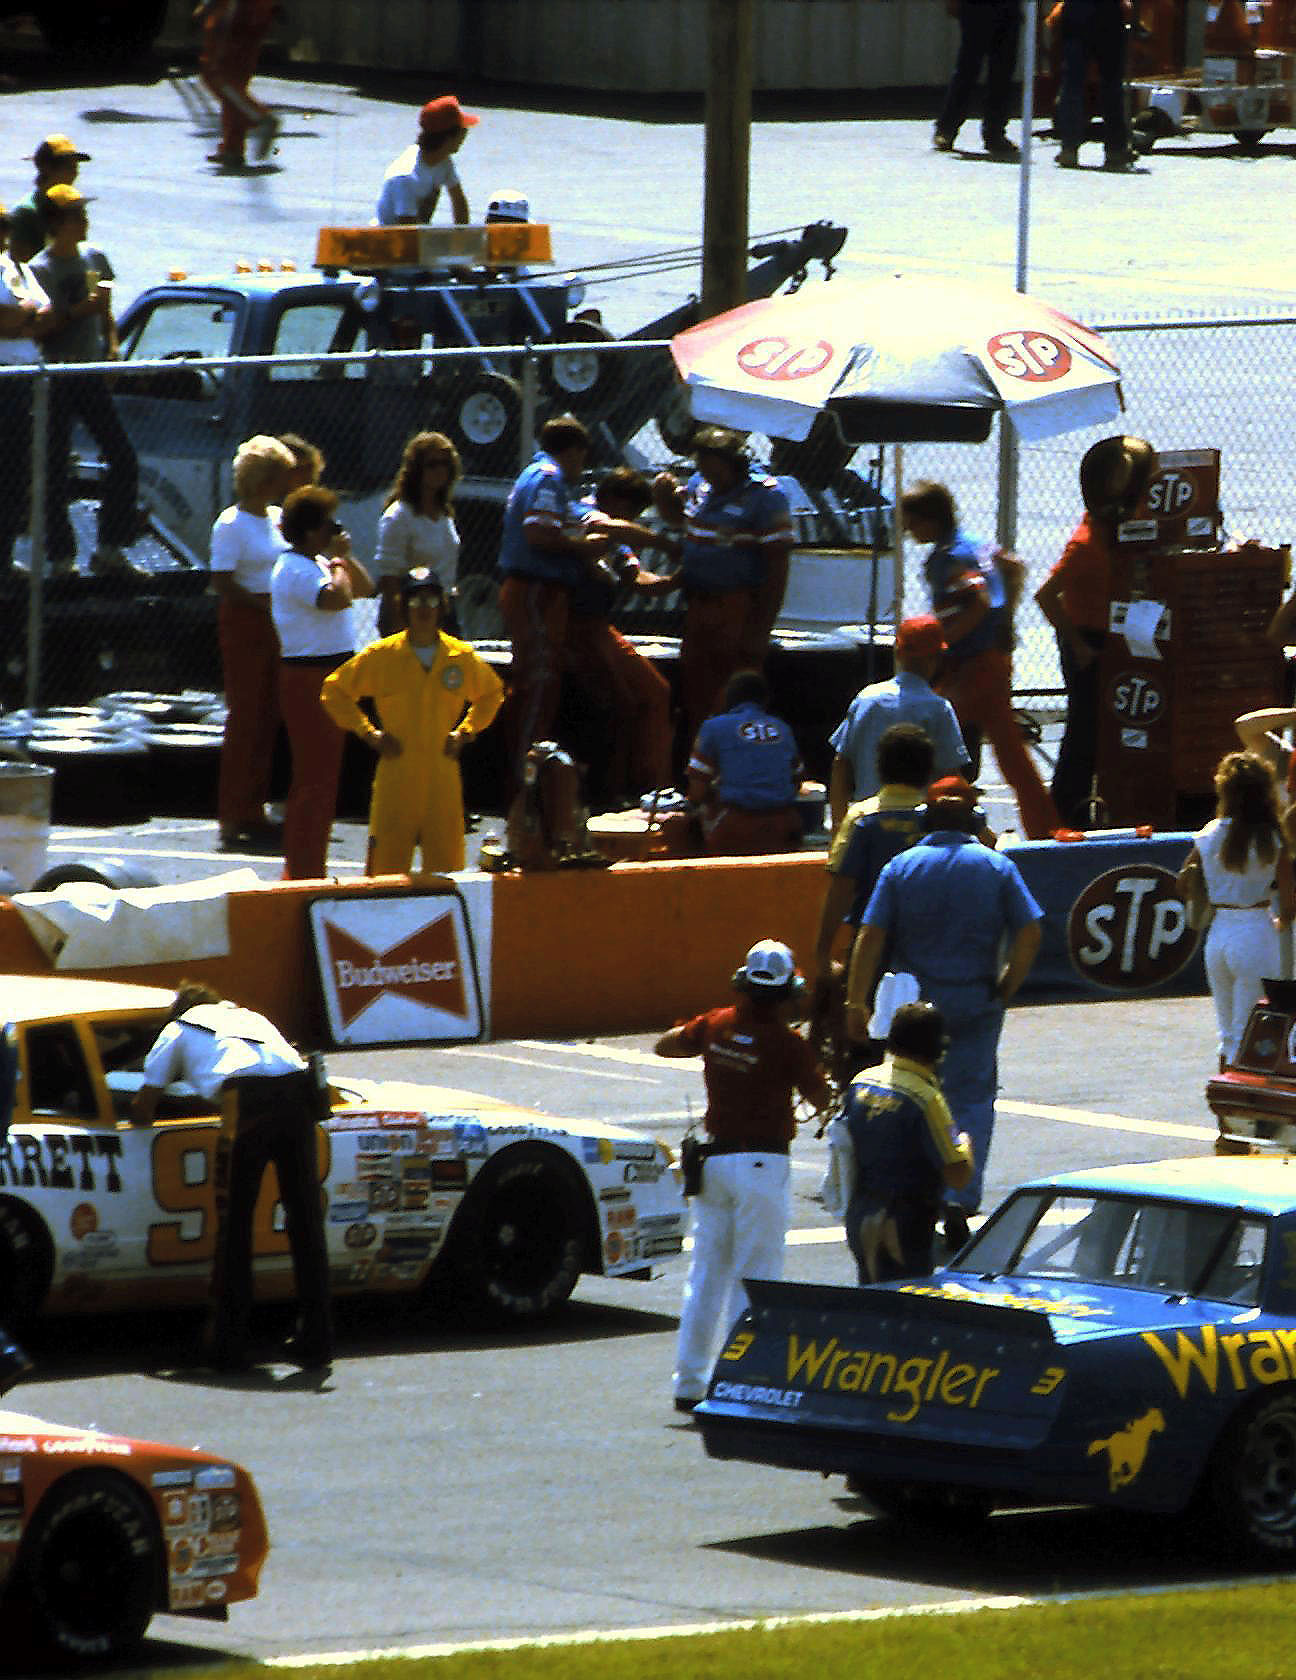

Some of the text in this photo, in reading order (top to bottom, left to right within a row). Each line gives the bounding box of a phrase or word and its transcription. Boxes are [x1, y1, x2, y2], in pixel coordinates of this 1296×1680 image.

[995, 332, 1059, 378] STP
[1148, 473, 1193, 513] STP
[1114, 677, 1160, 717] STP
[1080, 878, 1188, 973] STP
[336, 957, 457, 989] Budweiser
[722, 1332, 755, 1361] 3
[714, 1381, 803, 1408] CHEVROLET
[785, 1334, 1000, 1422] Wrangler
[1030, 1366, 1067, 1396] 3
